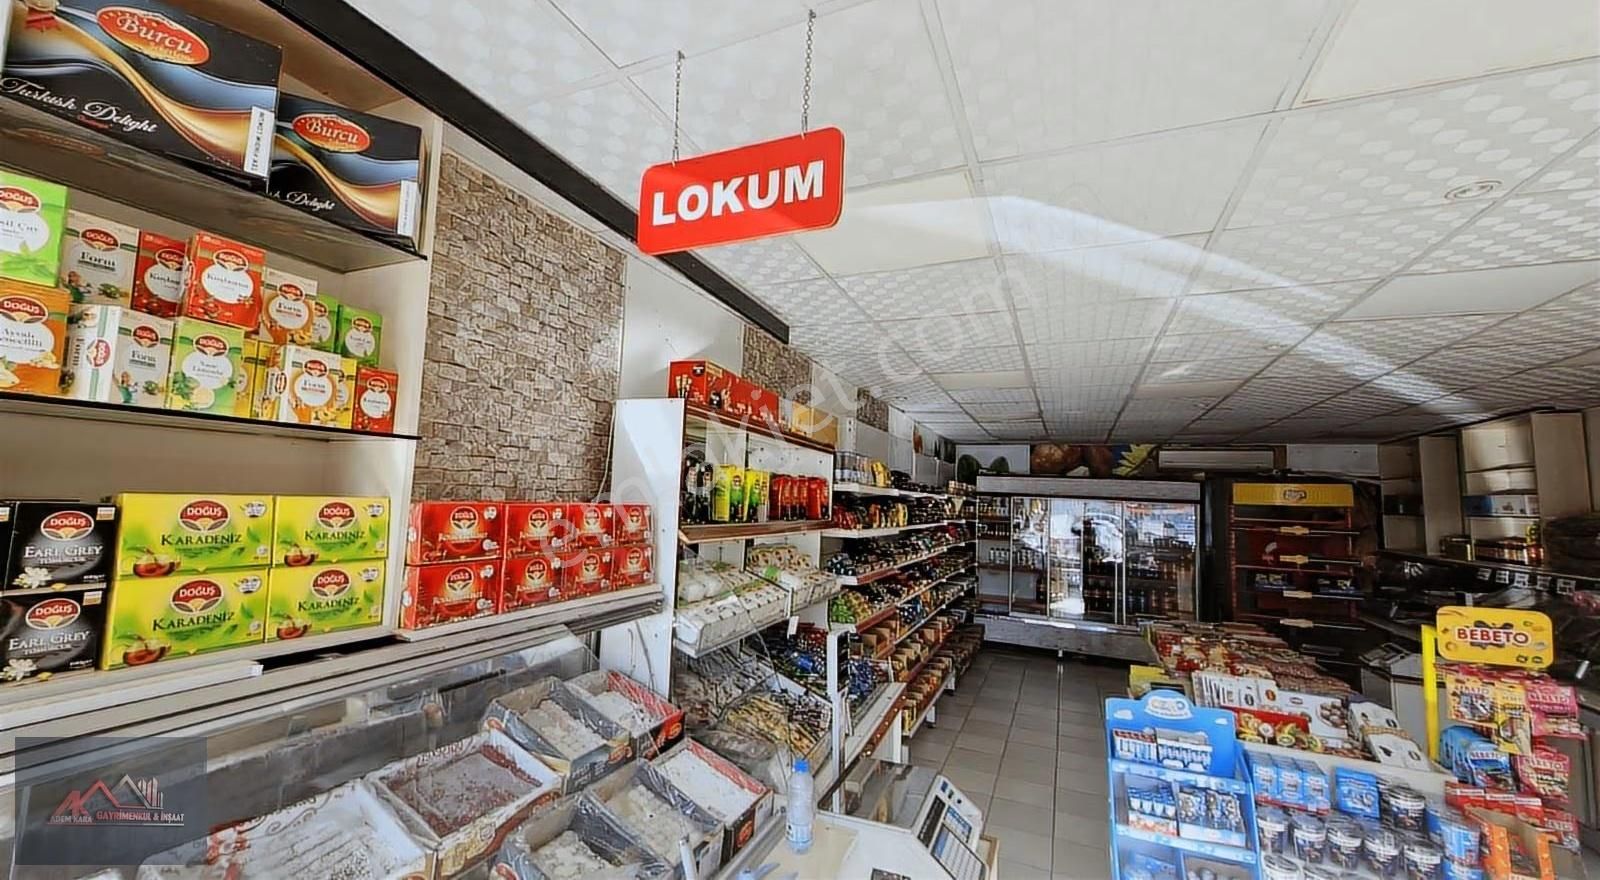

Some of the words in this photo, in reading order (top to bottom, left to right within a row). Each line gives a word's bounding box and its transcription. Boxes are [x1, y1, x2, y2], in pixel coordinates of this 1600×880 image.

[116, 12, 192, 54] Burcu
[0, 77, 77, 111] Turkish
[81, 101, 158, 133] Delight
[306, 118, 358, 144] Burcu
[286, 191, 336, 211] Delight
[652, 160, 824, 226] LOKUM
[187, 505, 223, 518] DOĞUŞ
[323, 506, 350, 518] DOĞUŞ
[50, 516, 87, 528] DOĞUŞ
[161, 531, 243, 547] KARADENİZ
[305, 530, 366, 541] KARADENİZ
[24, 545, 60, 560] EARL
[65, 544, 103, 557] GREY
[317, 573, 345, 586] DOĞUŞ
[179, 585, 216, 599] DOĞUŞ
[35, 603, 73, 617] DOĞUŞ
[298, 596, 360, 612] KARADENİZ
[152, 611, 235, 631] KARADENİZ
[9, 637, 44, 651] EARL
[51, 630, 90, 645] GREY
[1457, 628, 1529, 644] BEBETO
